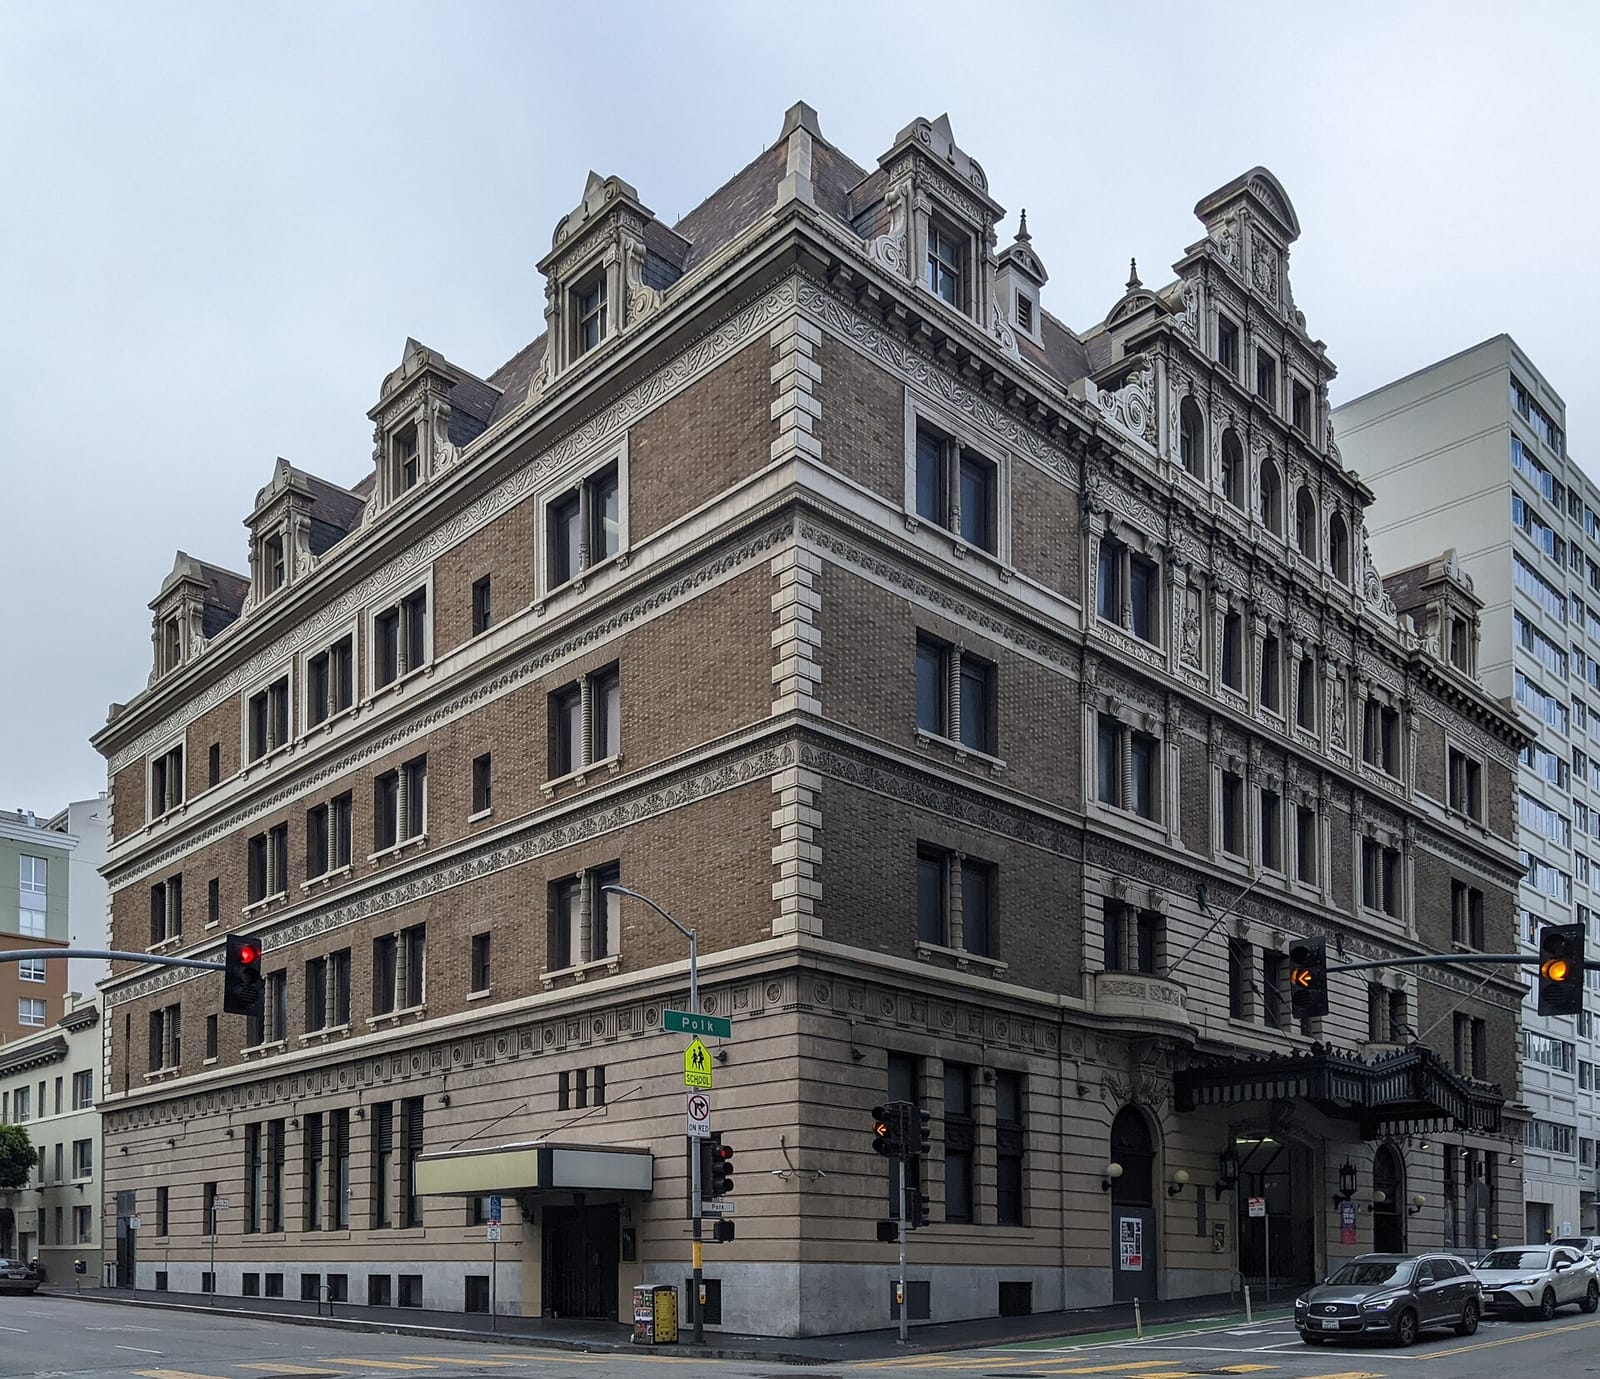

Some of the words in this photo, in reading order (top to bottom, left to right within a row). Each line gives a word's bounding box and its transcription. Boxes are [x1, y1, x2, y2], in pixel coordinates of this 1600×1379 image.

[682, 1017, 714, 1032] Polk
[686, 1074, 710, 1086] SCHOOL
[688, 1123, 697, 1132] ON
